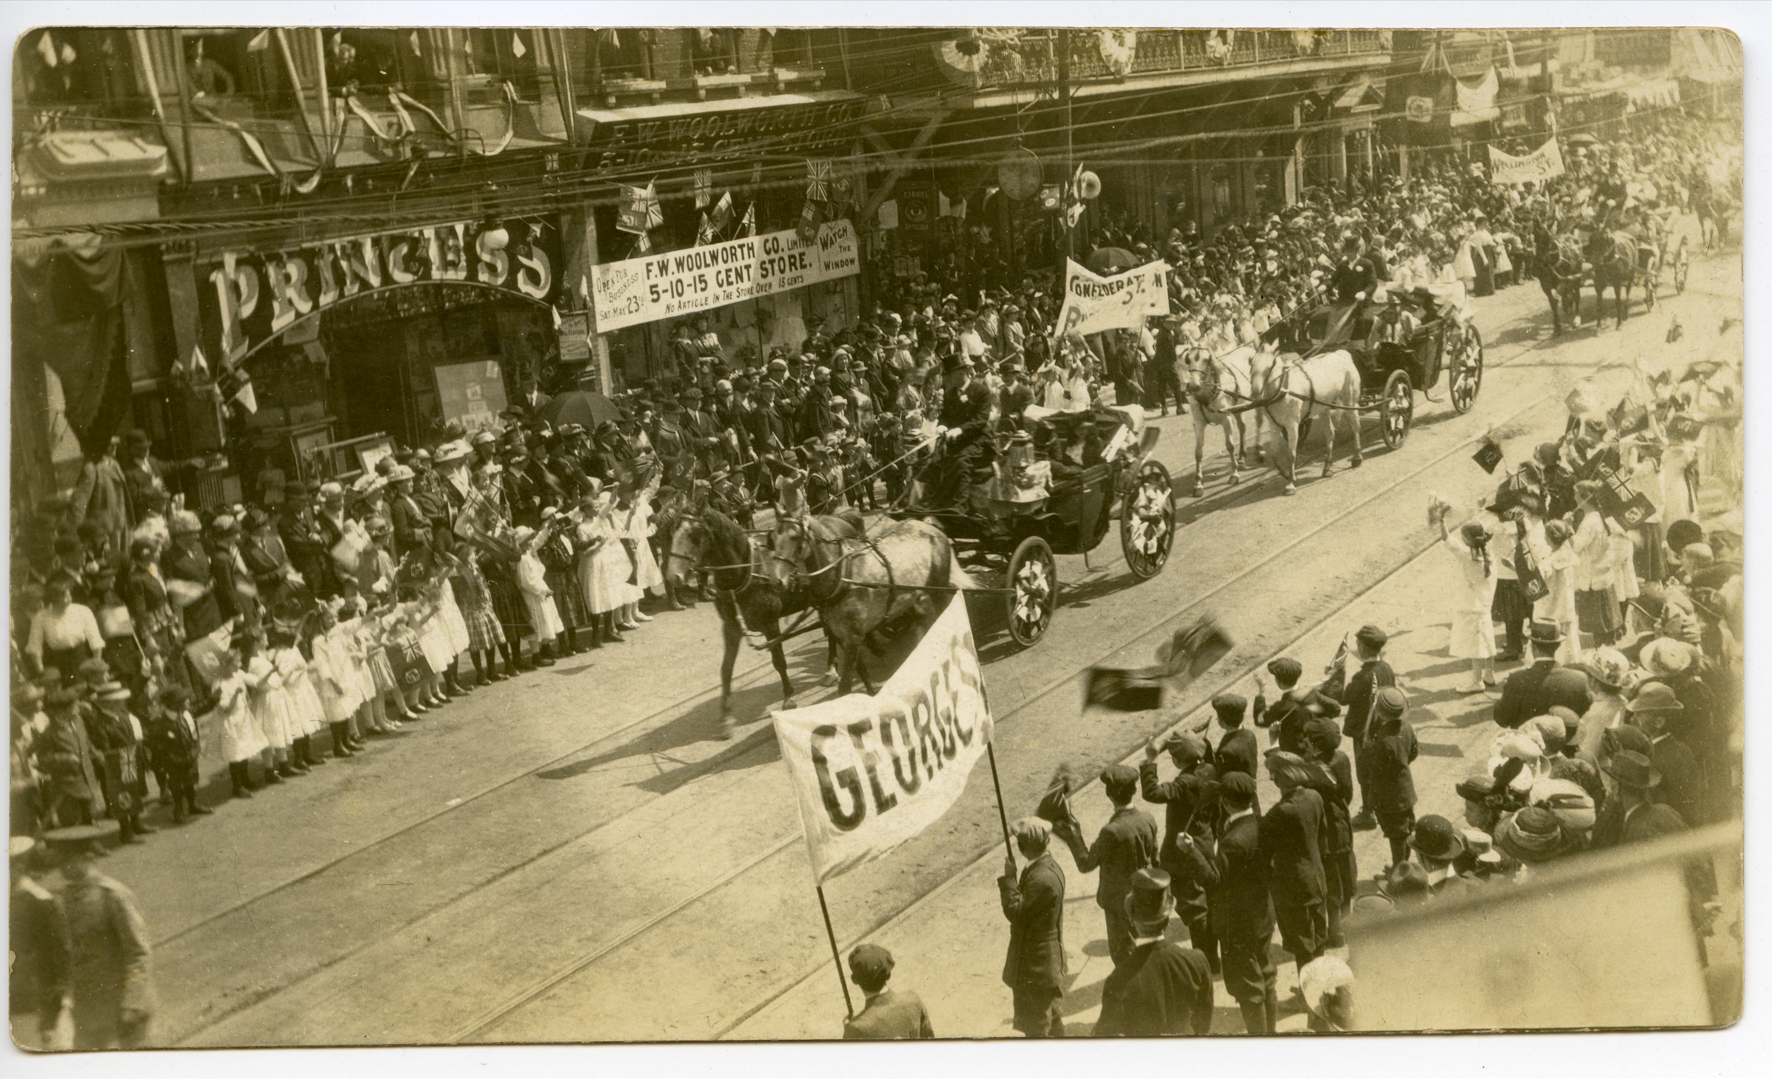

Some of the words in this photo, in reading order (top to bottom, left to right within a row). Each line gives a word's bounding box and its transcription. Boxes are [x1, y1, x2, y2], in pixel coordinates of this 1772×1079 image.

[668, 106, 818, 141] WOOLWORTH
[763, 236, 784, 256] CO.
[820, 225, 848, 252] WATCH
[839, 244, 851, 254] THE
[649, 273, 708, 303] 5-10-15
[715, 263, 752, 288] CENT
[760, 251, 812, 279] STORE.
[824, 257, 855, 272] WINDOW
[209, 228, 552, 352] PRINCESS
[596, 276, 615, 293] OPEN
[616, 268, 628, 284] FOR
[608, 272, 639, 303] BUSINESS
[677, 296, 708, 311] ARTICLE
[713, 292, 720, 304] IN
[723, 289, 732, 302] THE
[736, 285, 753, 299] STORE
[756, 281, 773, 294] OVER
[778, 277, 785, 289] 15
[787, 274, 804, 286] CENTS
